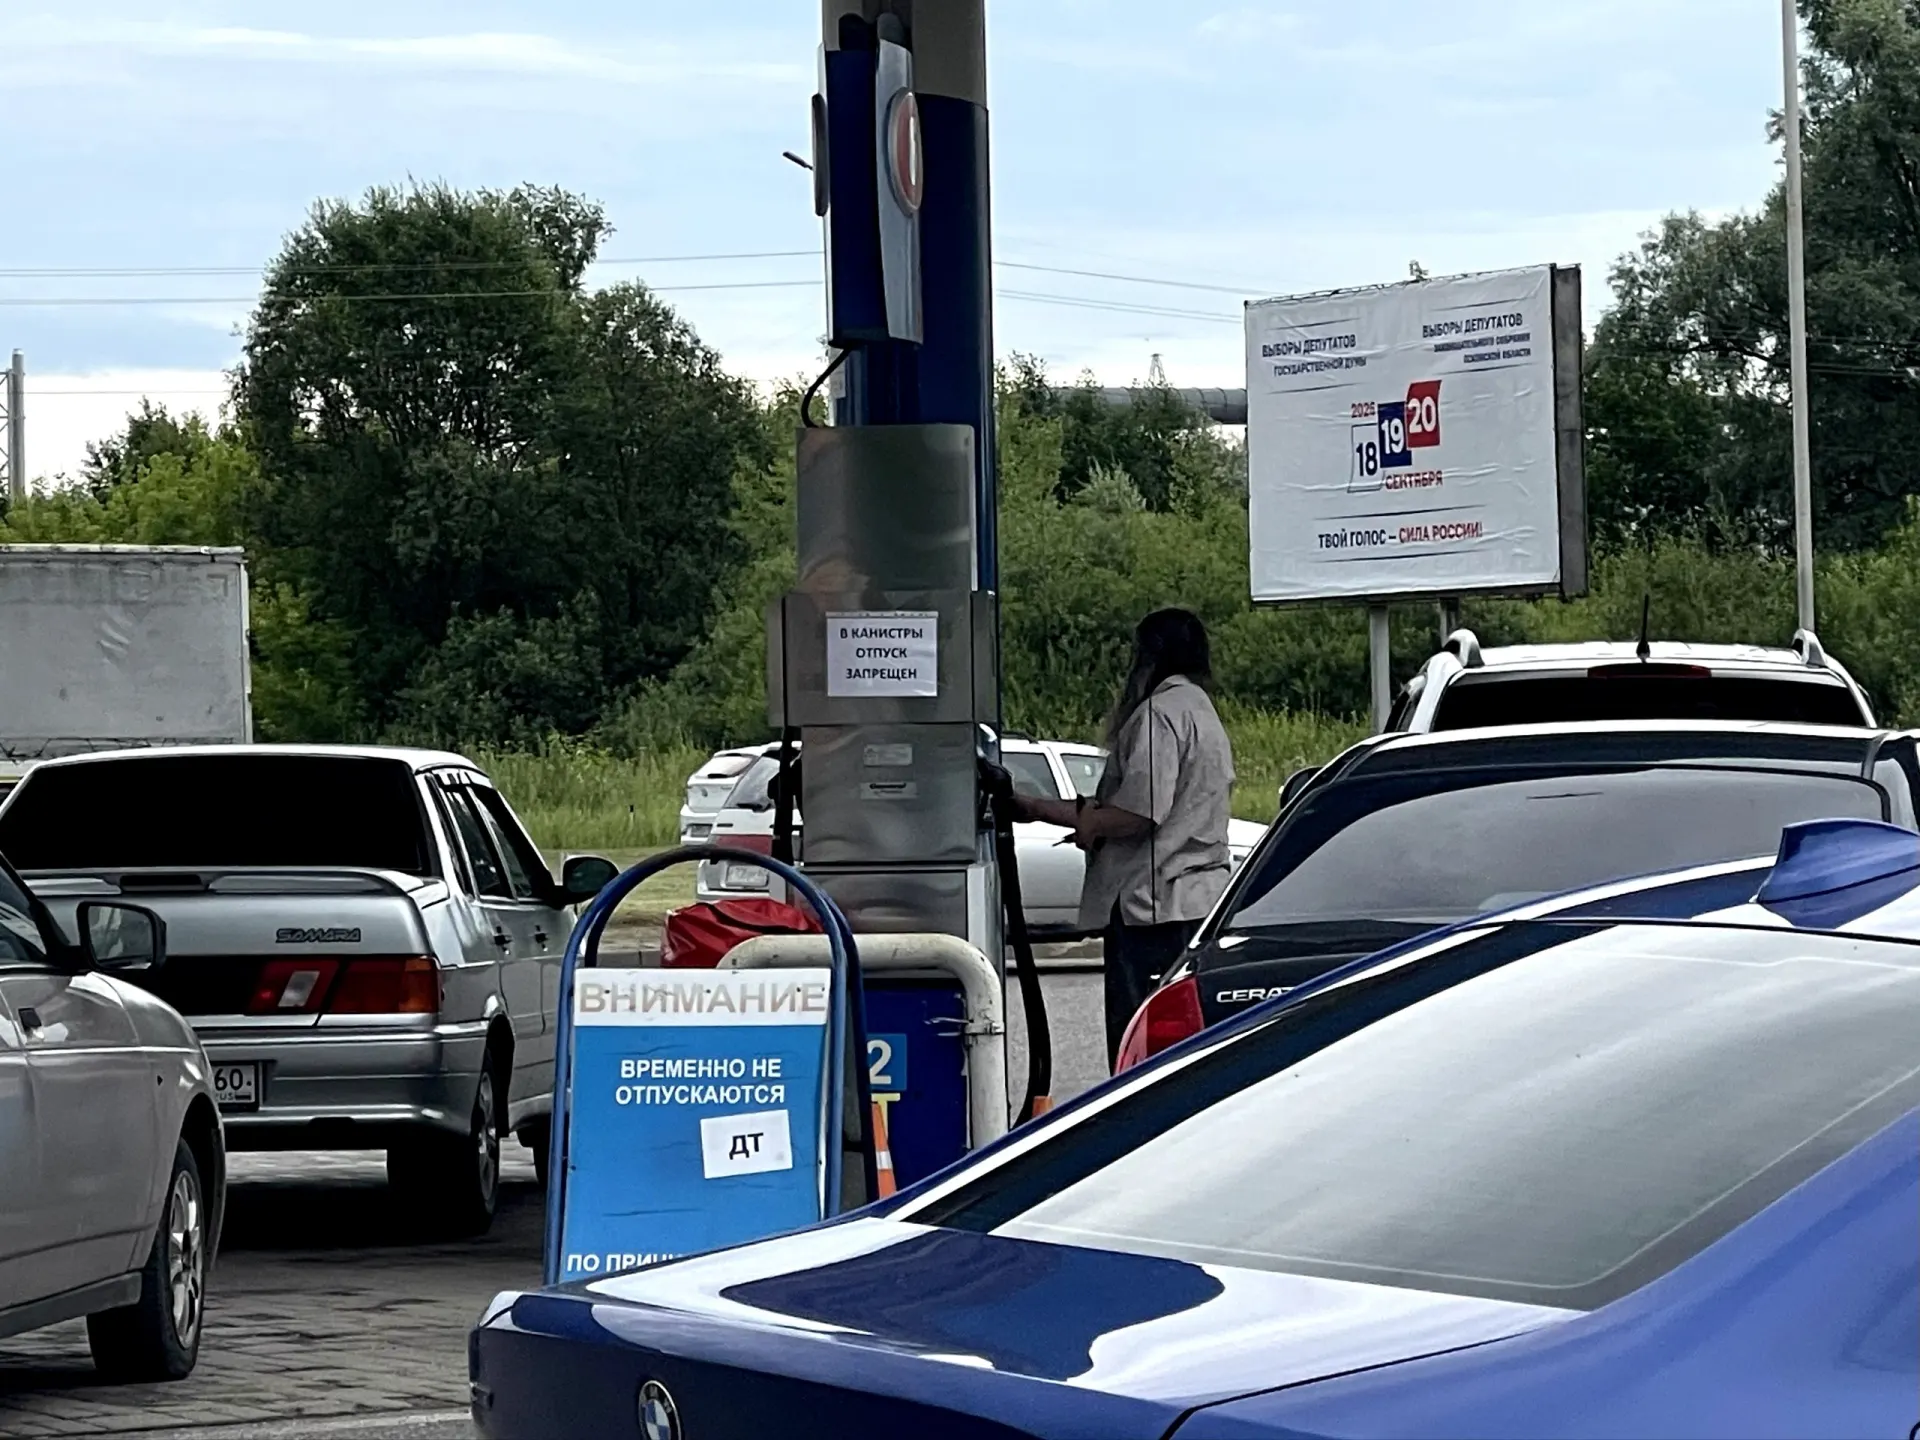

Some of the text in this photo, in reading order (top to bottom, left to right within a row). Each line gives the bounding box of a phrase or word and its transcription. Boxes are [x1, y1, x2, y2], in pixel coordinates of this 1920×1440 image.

[1423, 313, 1523, 338] ВЫБОРЫ ДЕПУТАТОВ
[1262, 334, 1356, 357] ВЫБОРЫ ДЕПУТАТОВ
[1356, 396, 1436, 477] 18 19 20
[1385, 470, 1443, 489] СЕНТЯБРЯ
[1318, 528, 1348, 549] ТВОЙ
[1350, 529, 1386, 547] ГОЛОС
[1399, 526, 1430, 543] СИЛА
[1432, 521, 1483, 541] РОССИИ!
[840, 627, 923, 639] В КАНИСТРЫ
[855, 647, 908, 659] ОТПУСК
[846, 668, 917, 681] ЗАПРЕЩЕН
[275, 928, 361, 943] SAMARA
[579, 980, 827, 1015] ВНИМАНИЕ
[620, 1058, 782, 1079] ВРЕМЕННО НЕ
[214, 1068, 243, 1091] 60
[615, 1084, 785, 1105] ОТПУСКАЮТСЯ
[729, 1132, 764, 1160] ДТ
[567, 1254, 600, 1273] ПО
